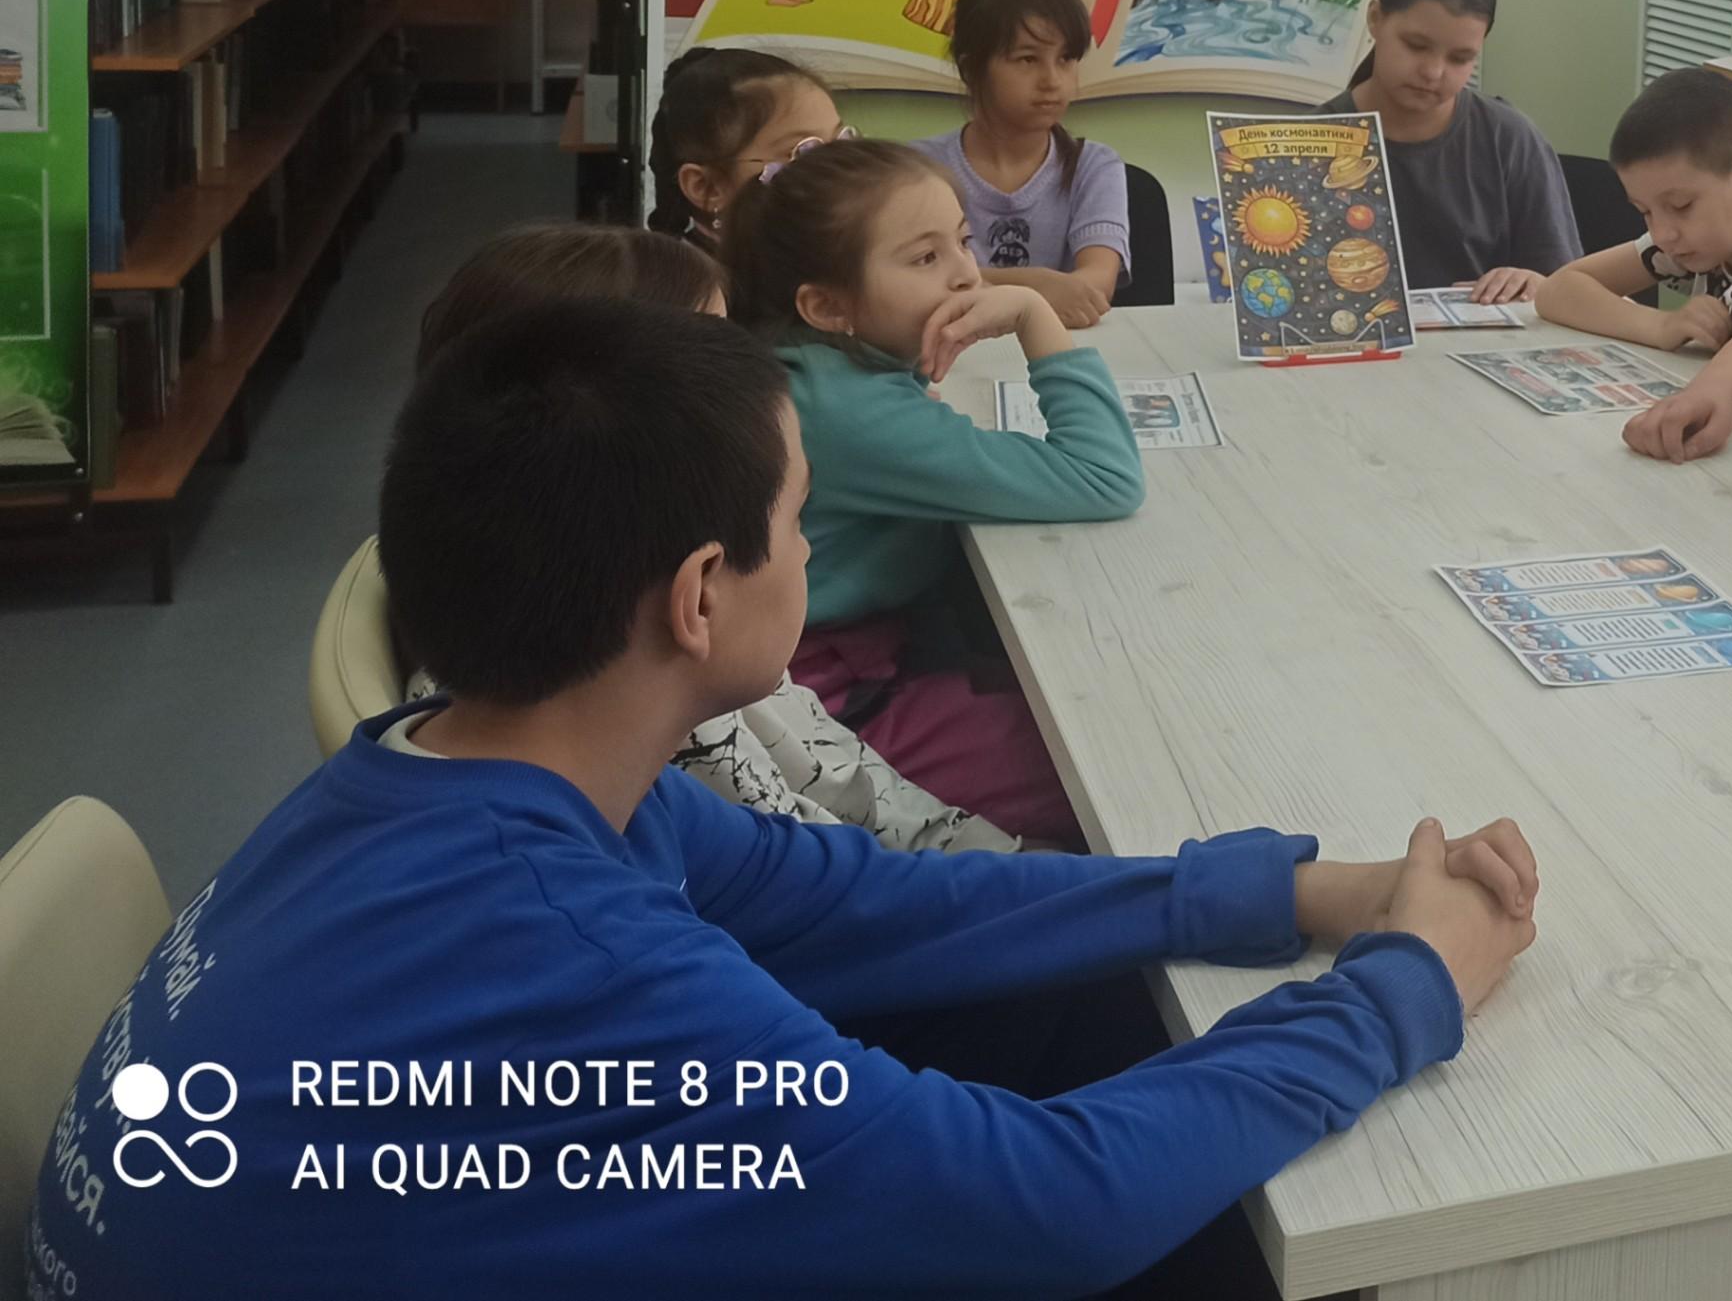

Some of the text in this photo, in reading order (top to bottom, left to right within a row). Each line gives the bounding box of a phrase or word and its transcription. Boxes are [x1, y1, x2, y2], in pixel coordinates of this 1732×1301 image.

[1238, 128, 1354, 142] День космонавтики
[1264, 143, 1329, 157] 12 апреля
[160, 877, 219, 1022] Думай.
